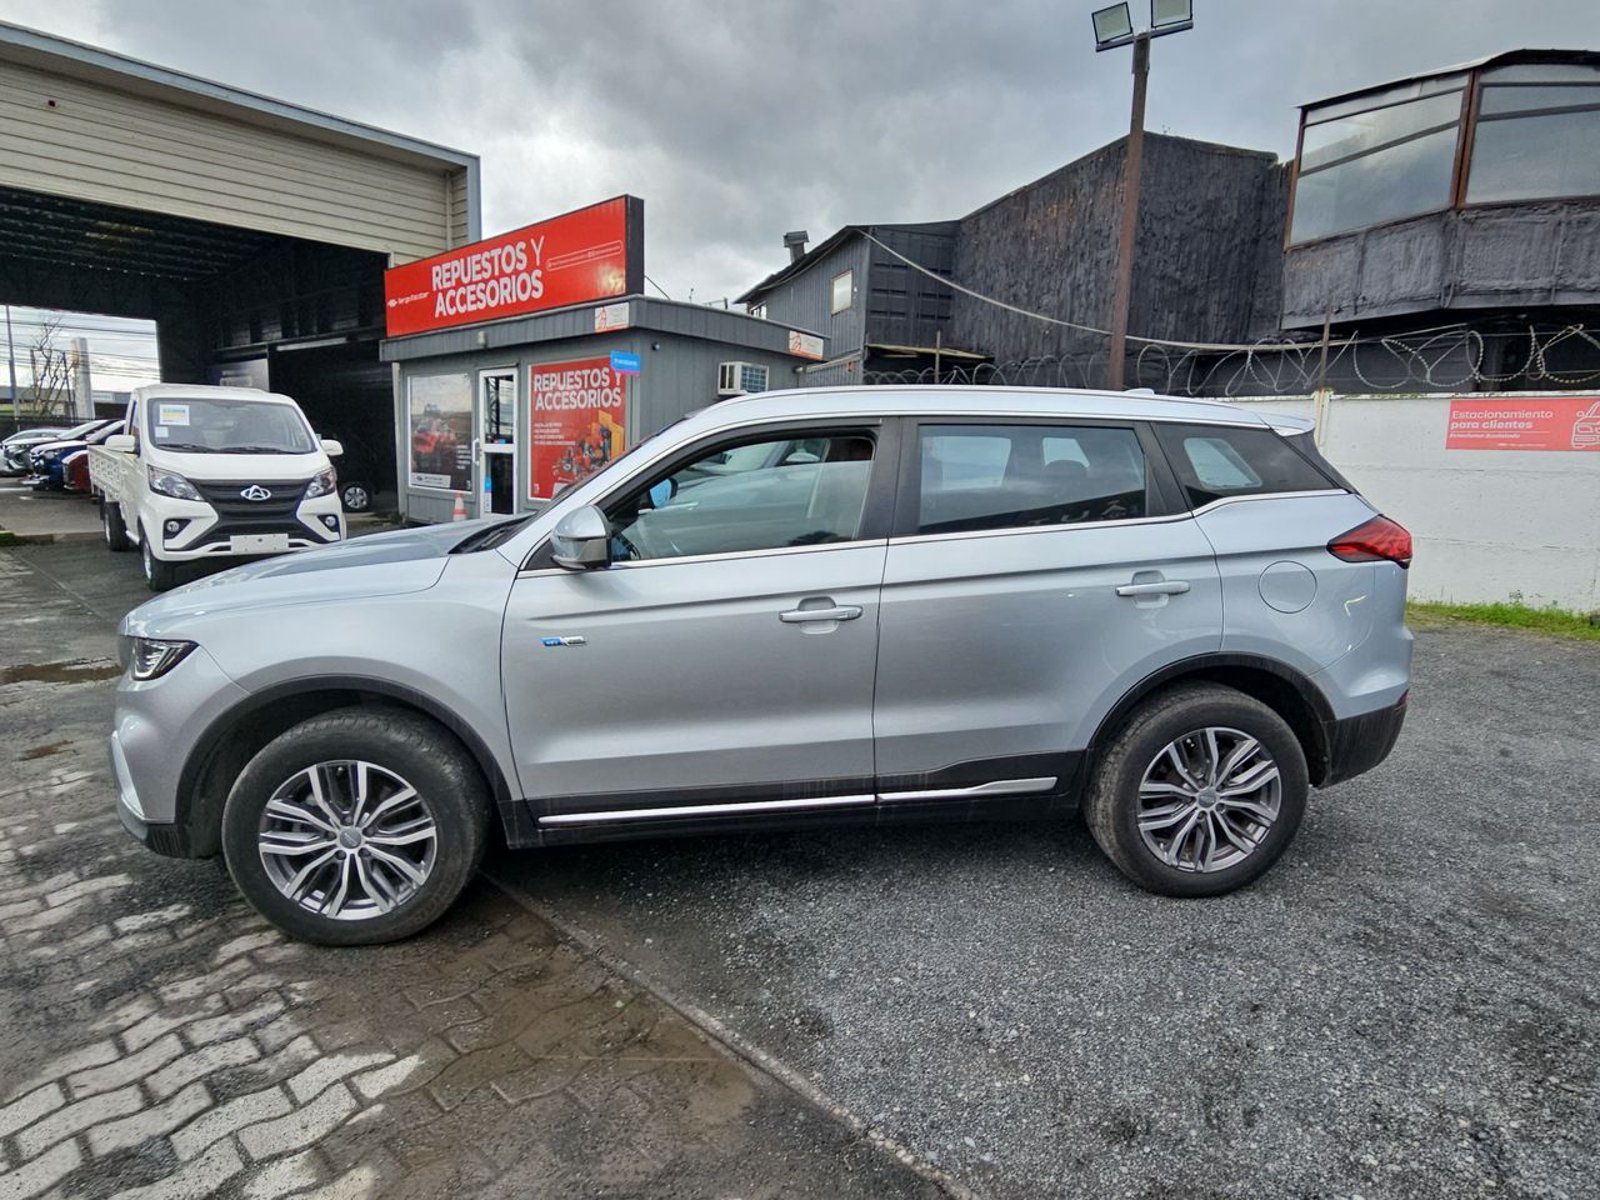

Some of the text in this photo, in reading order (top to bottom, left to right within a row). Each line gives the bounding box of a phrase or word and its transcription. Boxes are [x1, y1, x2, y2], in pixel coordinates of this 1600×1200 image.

[432, 241, 527, 292] REPUESTOS
[530, 235, 545, 267] Y
[434, 269, 544, 319] ACCESORIOS
[534, 367, 610, 392] REPUESTOS
[535, 387, 621, 411] ACCESORIOS
[1450, 419, 1534, 430] para clientes
[1452, 409, 1553, 420] Estacionamiento
